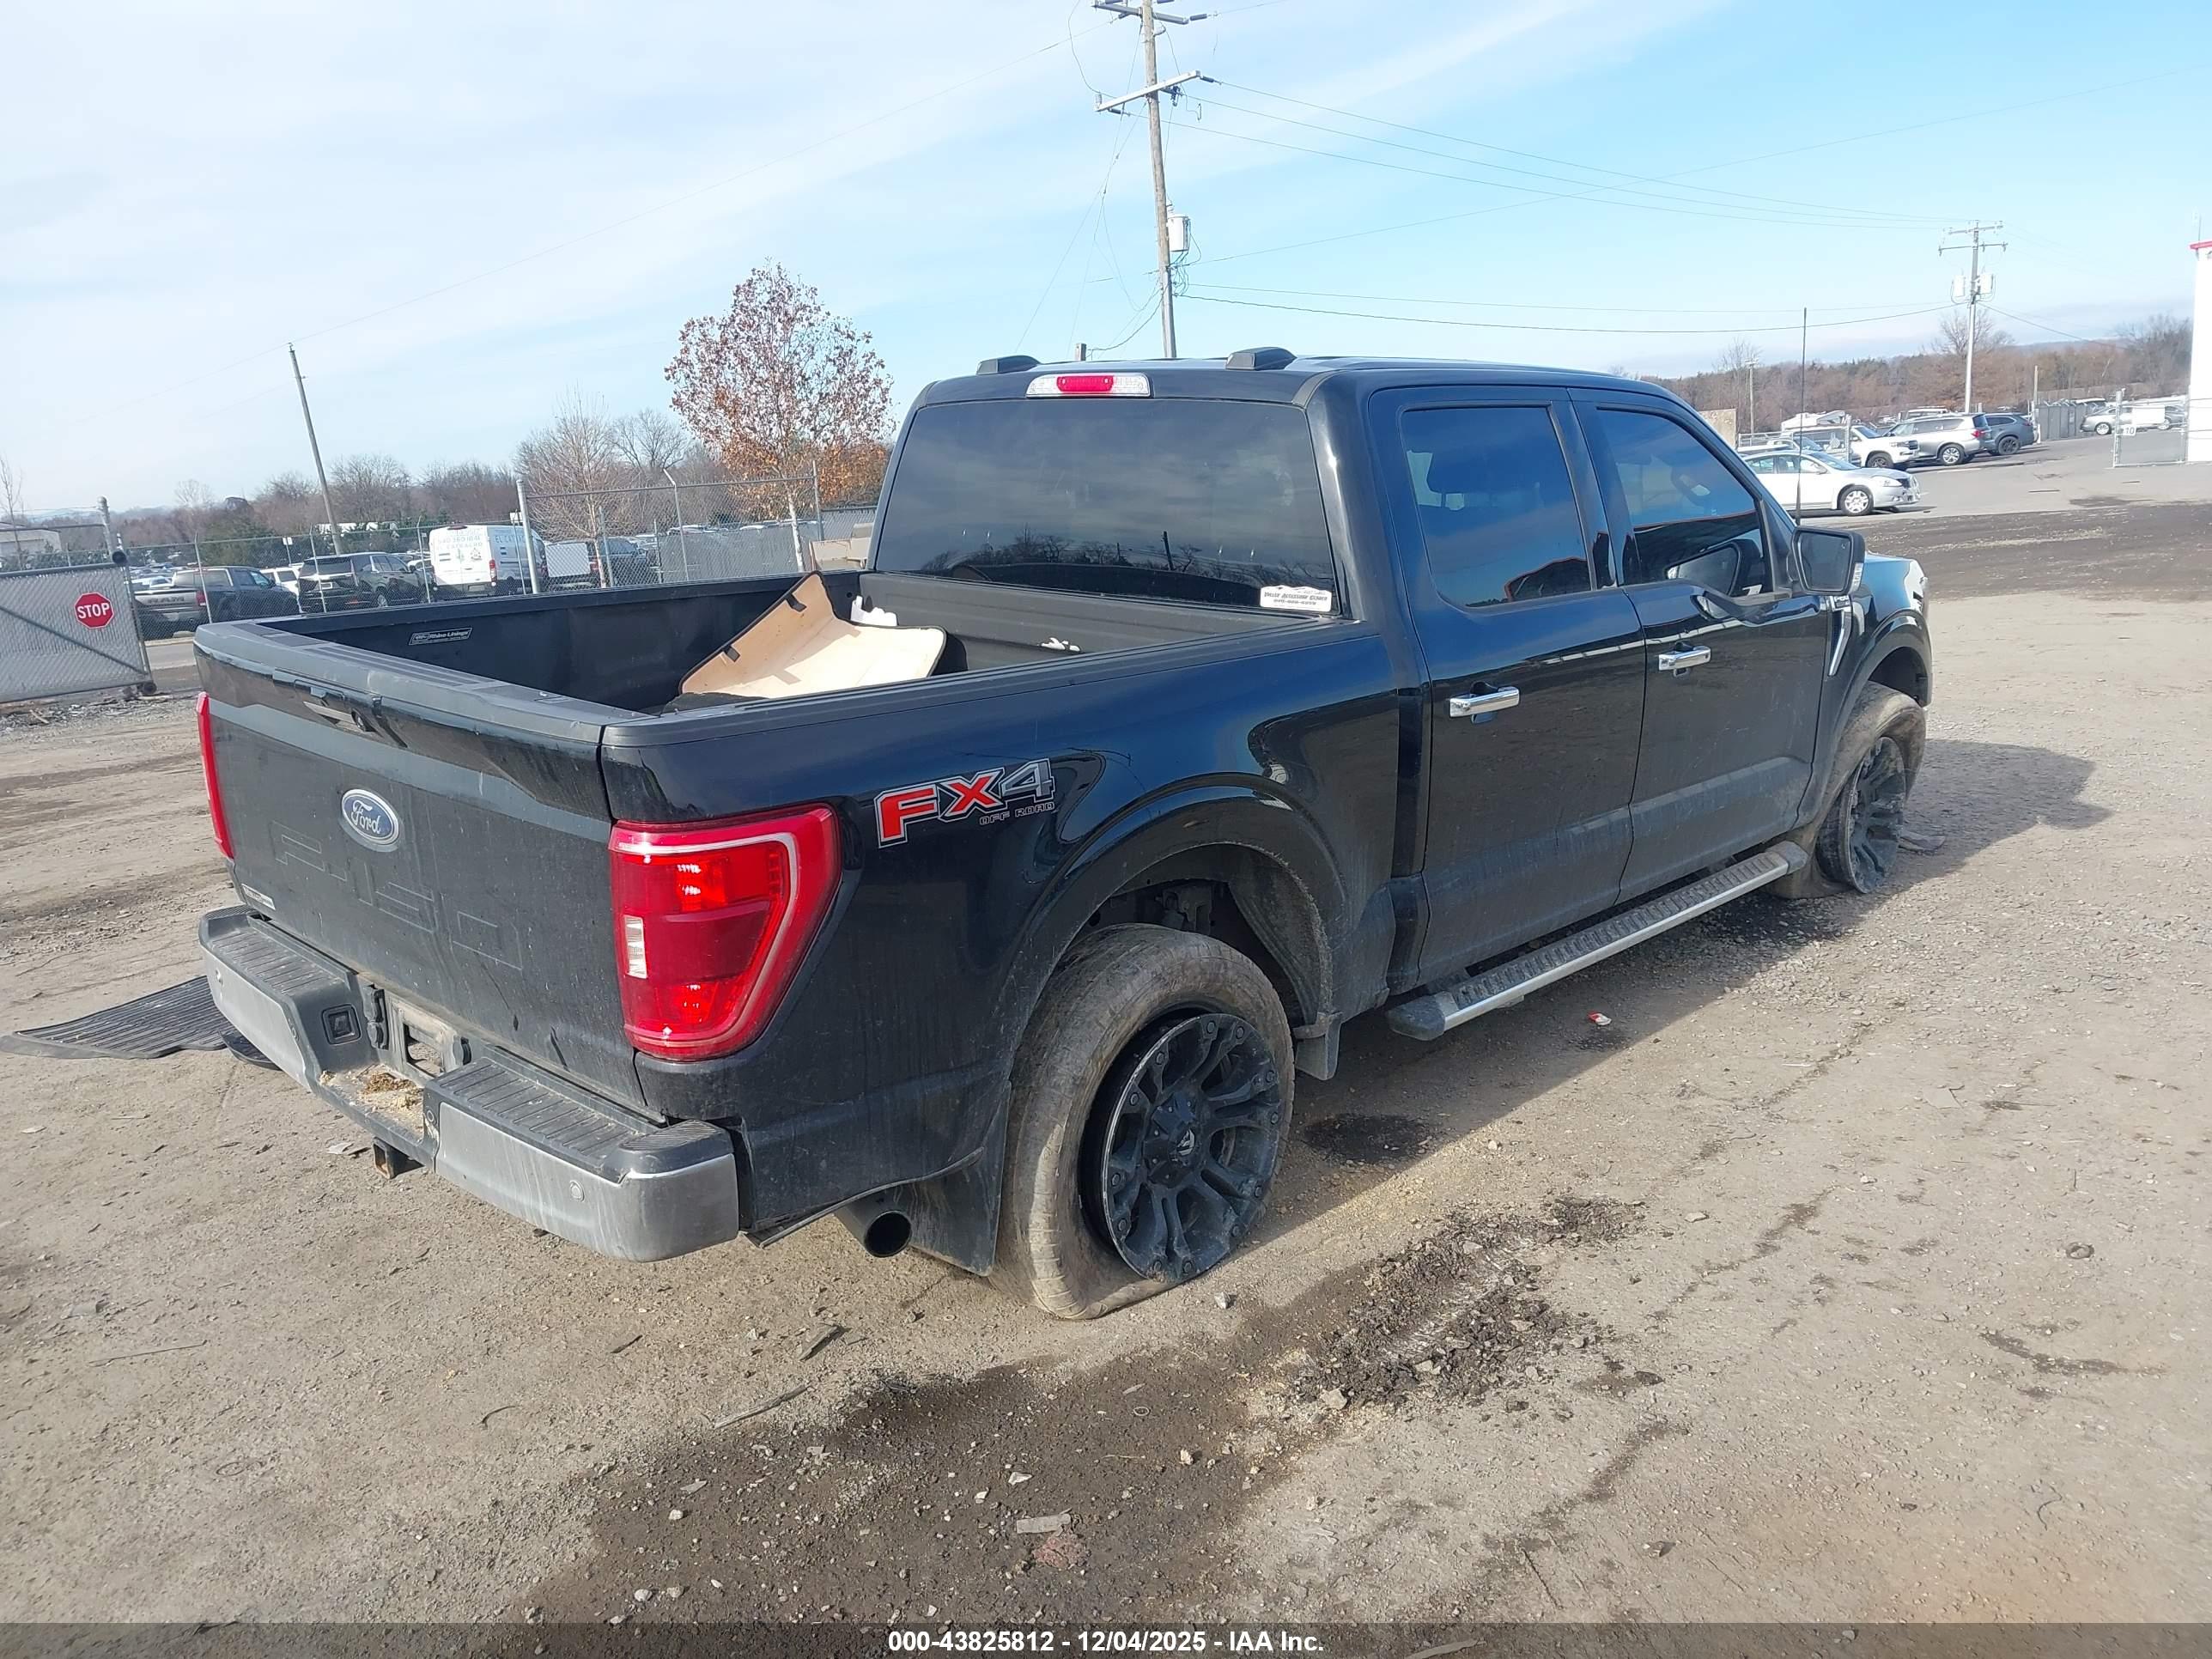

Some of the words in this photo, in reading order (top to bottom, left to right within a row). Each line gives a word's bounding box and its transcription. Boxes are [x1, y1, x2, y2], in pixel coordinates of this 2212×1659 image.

[77, 602, 110, 619] STOP
[350, 799, 381, 835] Ford
[874, 758, 1055, 848] FX4
[979, 811, 1010, 825] OFF
[1014, 801, 1055, 817] ROAD
